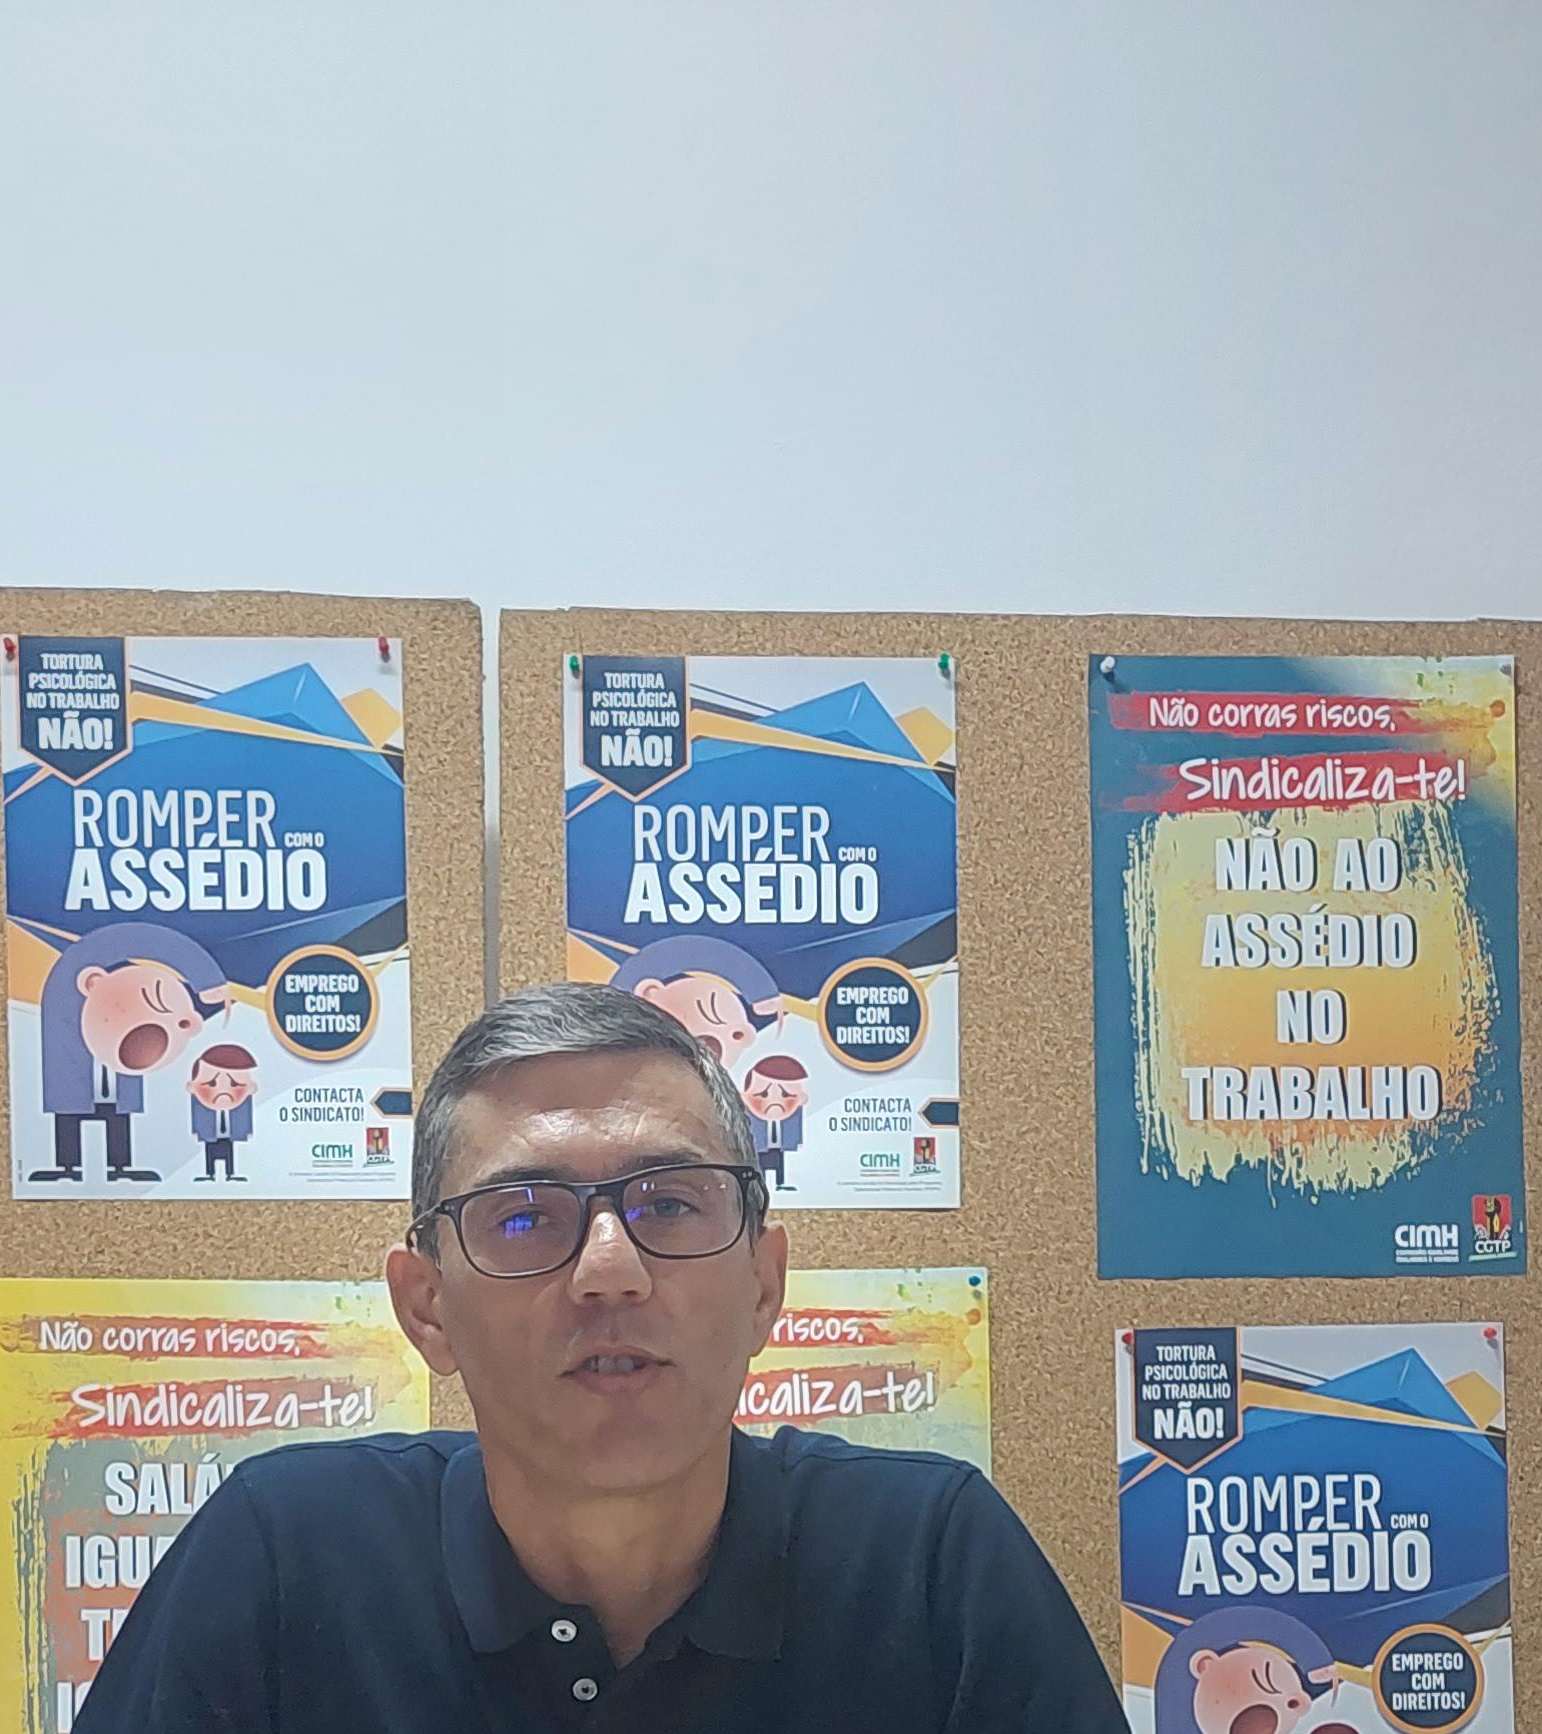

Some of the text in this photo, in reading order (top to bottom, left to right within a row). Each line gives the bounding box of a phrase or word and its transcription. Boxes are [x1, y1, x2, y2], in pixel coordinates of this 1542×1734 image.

[41, 653, 104, 671] TORTURA
[28, 671, 116, 690] PSICOLÓGICA
[604, 673, 665, 689] TORTURA
[27, 693, 119, 710] NO TRABALHO
[592, 690, 677, 709] PSICOLÓGICA
[590, 710, 680, 727] NO TRABALHO
[1149, 699, 1199, 727] Não
[1208, 702, 1298, 728] corras
[38, 711, 114, 751] NÃO!
[601, 729, 672, 767] NÃO!
[1179, 758, 1467, 801] Sindicaliza-te!
[75, 790, 324, 848] ROMPER COM O
[635, 806, 877, 862] ROMPER COM O
[1215, 827, 1400, 893] NÃO AO
[65, 833, 327, 911] ASSÉDIO
[624, 848, 878, 923] ASSÉDIO
[1201, 903, 1415, 968] ASSÉDIO
[285, 975, 359, 994] EMPREGO
[304, 995, 340, 1013] COM
[837, 987, 909, 1005] EMPREGO
[285, 1013, 361, 1034] DIREITOS!
[855, 1006, 890, 1025] COM
[1276, 990, 1346, 1044] NO
[836, 1025, 910, 1045] DIREITOS!
[295, 1087, 364, 1103] CONTACTA
[1181, 1066, 1441, 1121] TRABALHO
[279, 1107, 364, 1122] O SINDICATO!
[845, 1097, 912, 1113] CONTACTA
[829, 1116, 912, 1131] O SINDICATO!
[312, 1144, 353, 1159] CIMH
[860, 1153, 900, 1167] CIMH
[1395, 1224, 1459, 1248] CIMH
[1475, 1239, 1512, 1254] CGTP
[40, 1322, 93, 1351] Não
[102, 1325, 197, 1352] corras
[1157, 1345, 1216, 1362] TORTURA
[1145, 1363, 1228, 1381] PSICOLÓGICA
[1142, 1383, 1231, 1400] NO TRABALHO
[71, 1383, 373, 1429] Sindicaliza-te!
[1153, 1402, 1223, 1440] NÃO!
[105, 1452, 235, 1516] SALÁ
[1188, 1474, 1428, 1533] ROMPER COM O
[1178, 1518, 1432, 1596] ASSÉDIO
[1392, 1654, 1464, 1673] EMPREGO
[1411, 1674, 1446, 1691] COM
[1392, 1693, 1465, 1711] DIREITOS!
